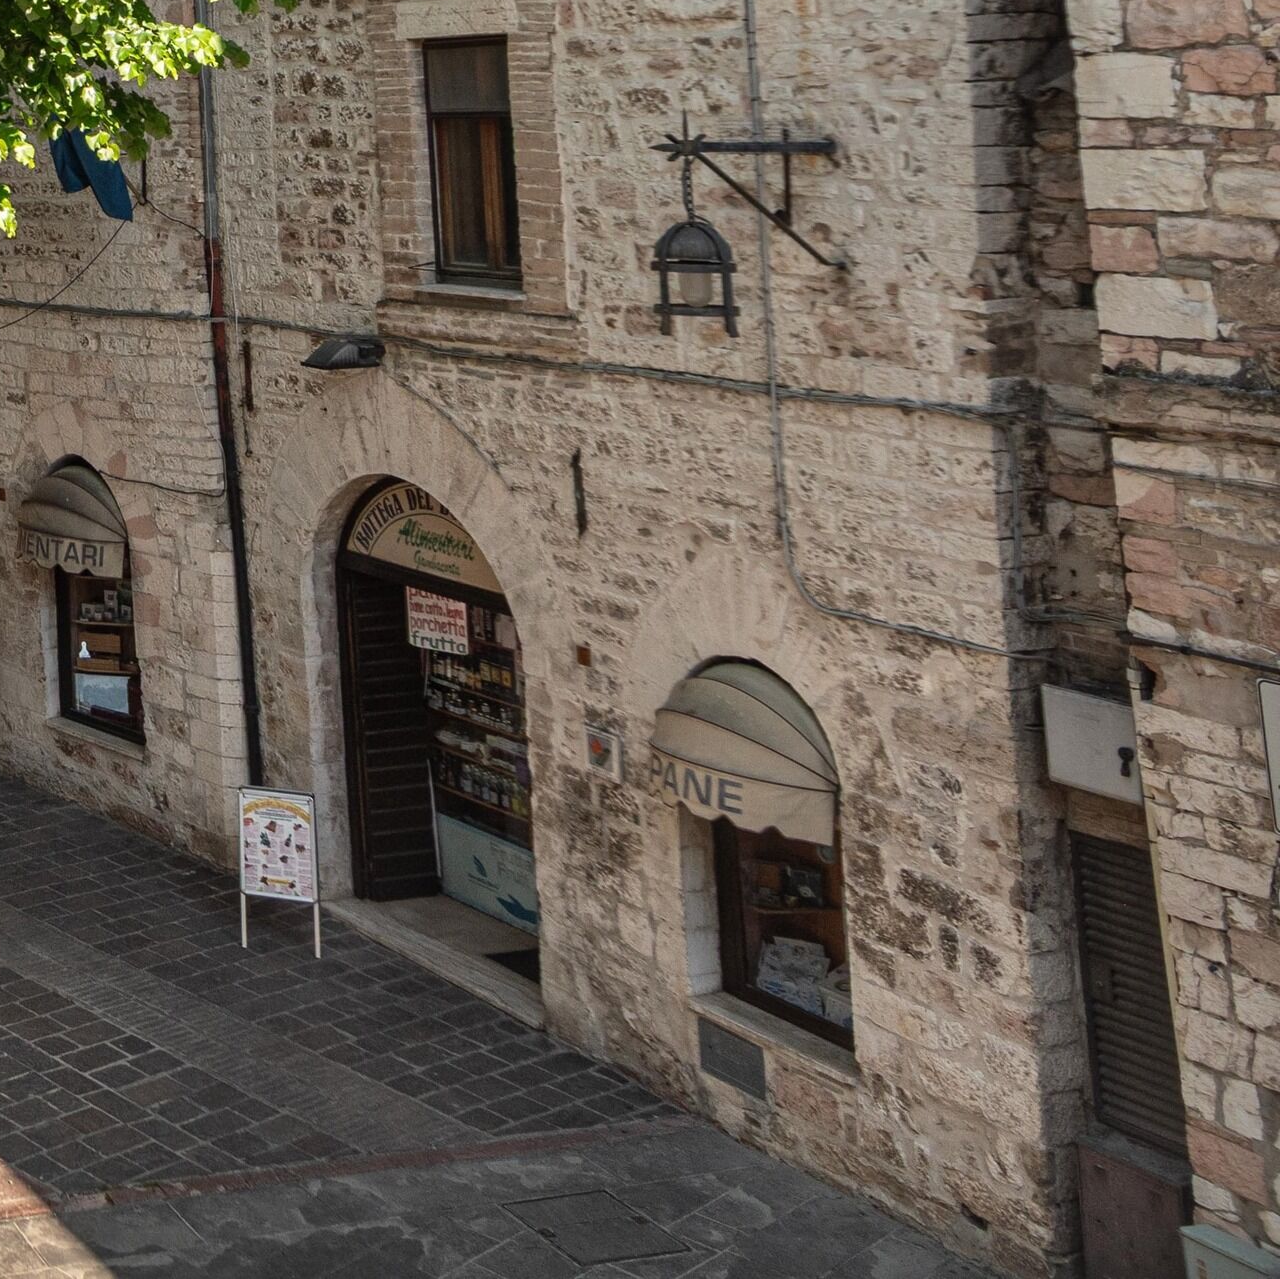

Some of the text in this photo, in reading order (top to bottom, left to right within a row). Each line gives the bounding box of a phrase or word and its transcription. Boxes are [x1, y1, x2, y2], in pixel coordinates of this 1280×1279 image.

[356, 487, 433, 551] BOTTEGA DEL
[397, 518, 475, 561] Alimentari
[410, 615, 466, 638] porchetta
[411, 630, 466, 654] frutta
[651, 752, 743, 815] PANE
